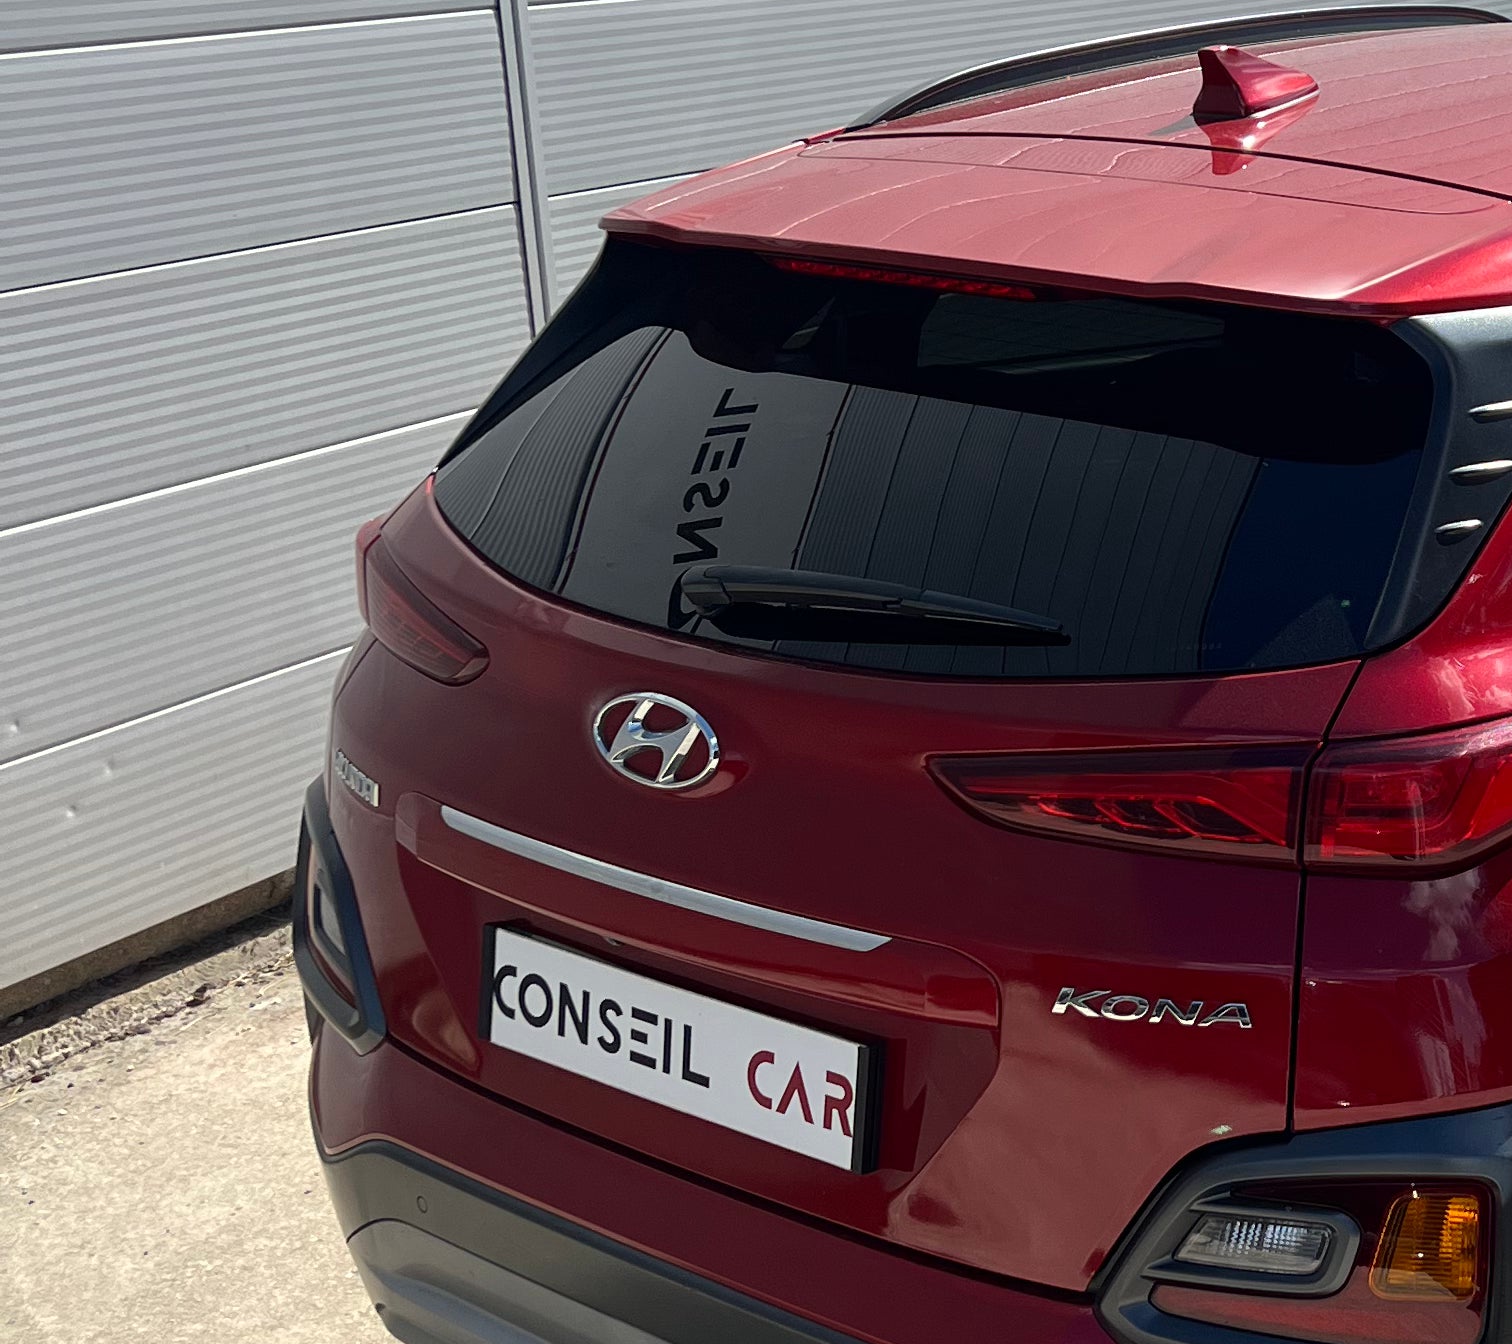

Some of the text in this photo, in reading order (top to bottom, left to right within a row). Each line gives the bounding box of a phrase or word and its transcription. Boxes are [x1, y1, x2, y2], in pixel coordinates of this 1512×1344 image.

[493, 964, 854, 1138] CONSEIL CAR
[1051, 987, 1252, 1028] KONA
